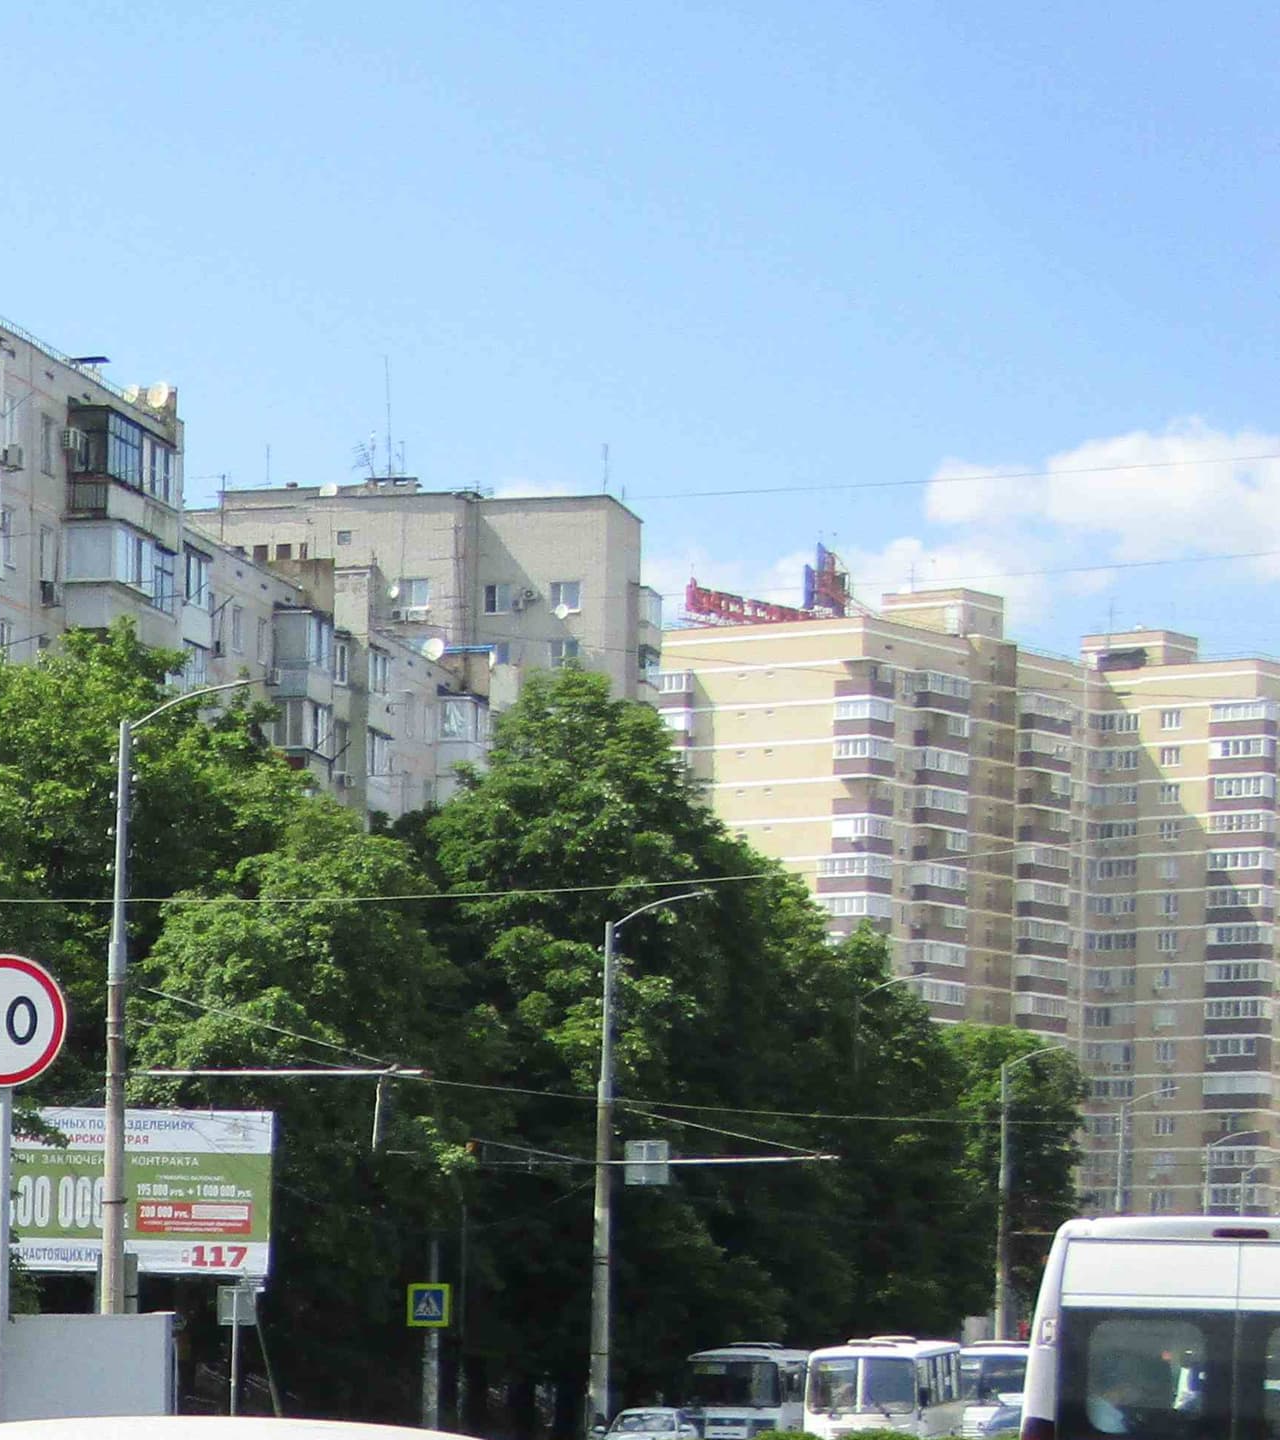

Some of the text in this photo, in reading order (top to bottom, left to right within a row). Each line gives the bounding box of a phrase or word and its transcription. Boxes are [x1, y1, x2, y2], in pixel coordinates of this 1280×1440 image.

[131, 1156, 200, 1167] КОНТРАКТА
[22, 1247, 83, 1262] НАСТОЯЩИХ
[191, 1246, 248, 1268] 117
